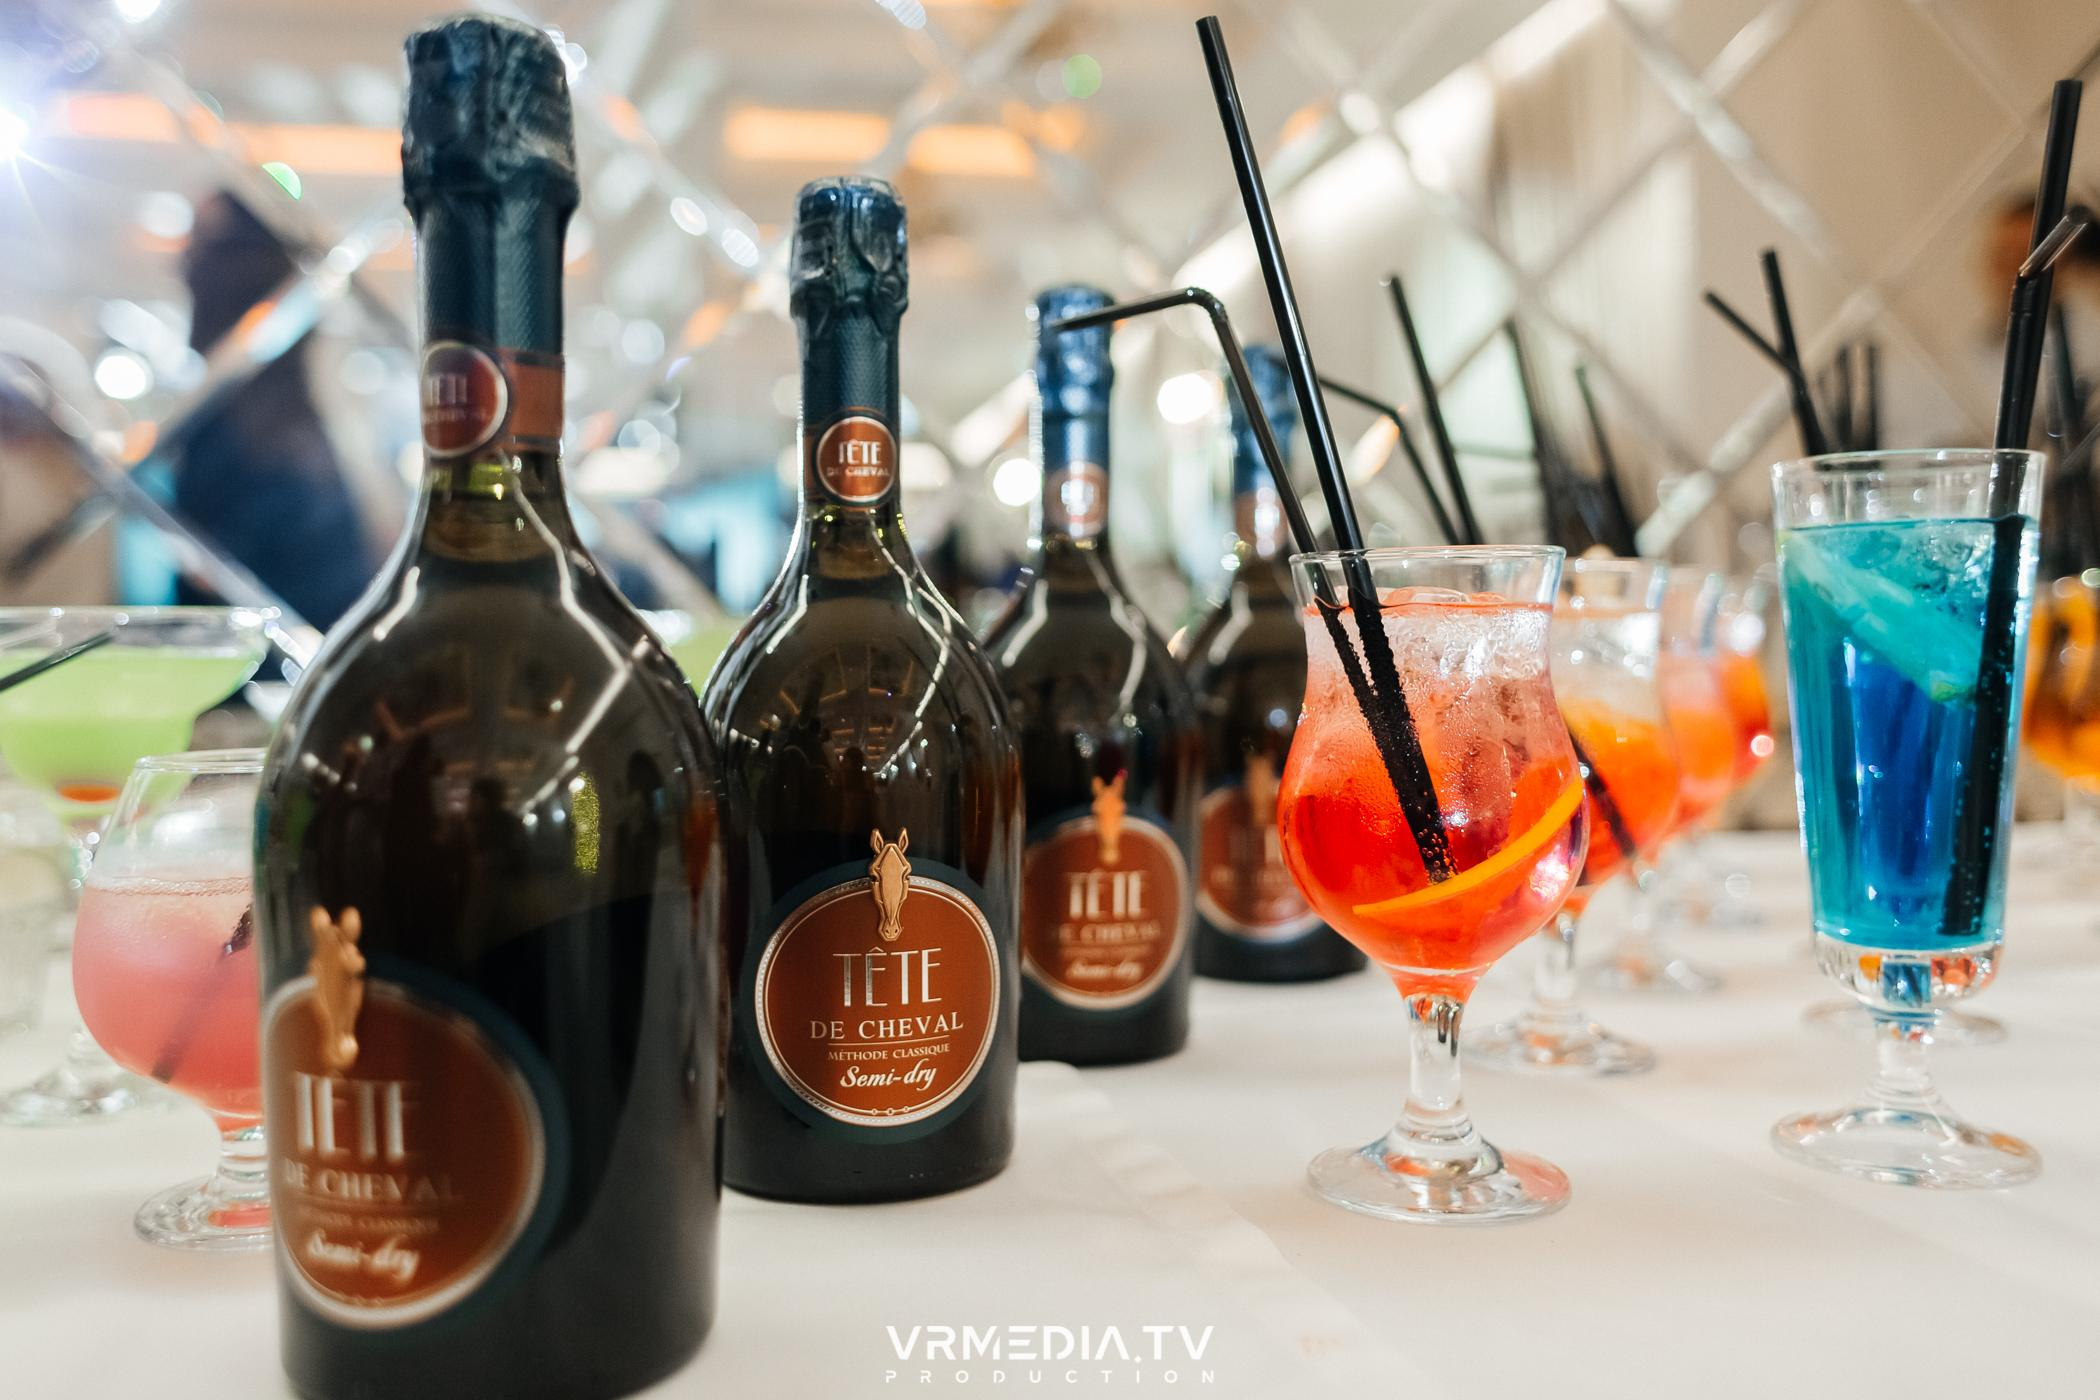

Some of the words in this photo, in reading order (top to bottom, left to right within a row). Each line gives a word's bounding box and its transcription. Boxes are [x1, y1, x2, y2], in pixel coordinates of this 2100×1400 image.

[832, 946, 942, 1007] TÊTE
[810, 1020, 845, 1040] DE
[858, 1011, 964, 1039] CHEVAL
[892, 1043, 950, 1059] CLASSIQUE
[840, 1058, 937, 1091] Semi-dry
